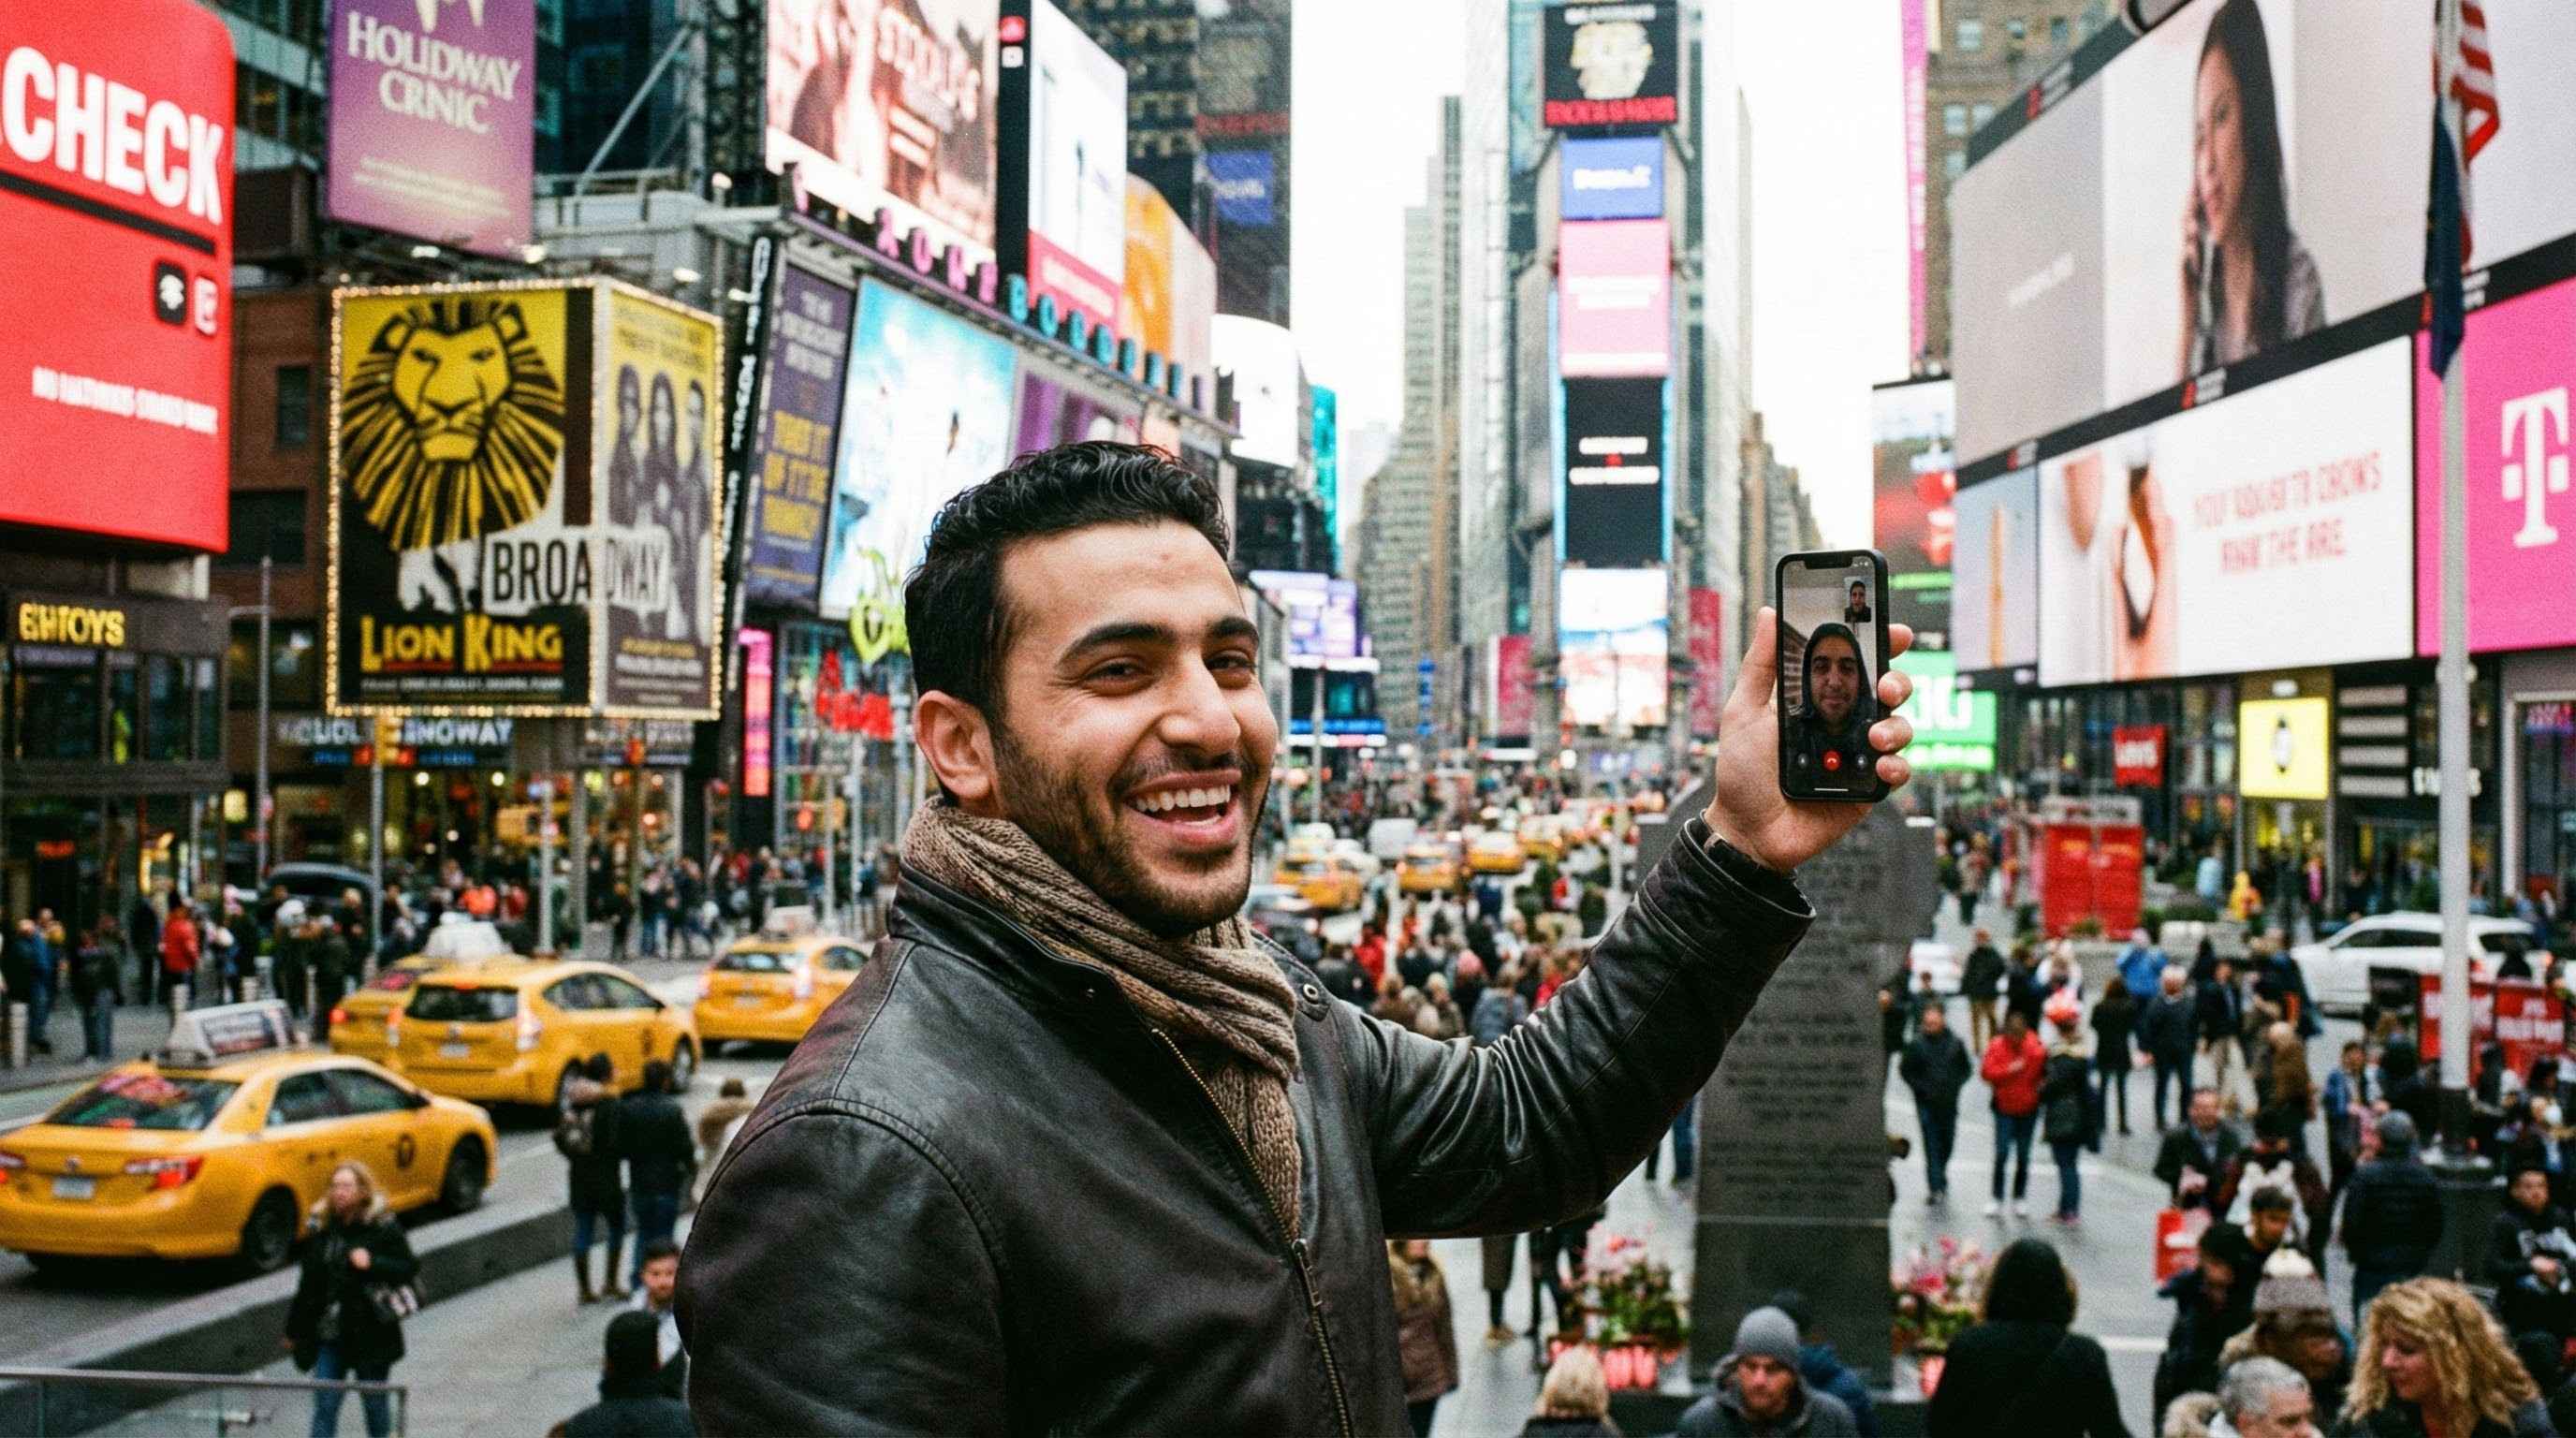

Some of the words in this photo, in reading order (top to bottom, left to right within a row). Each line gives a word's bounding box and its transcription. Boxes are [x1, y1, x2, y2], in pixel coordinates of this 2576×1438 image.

[3, 46, 225, 225] CHECK
[360, 615, 455, 673] LION
[463, 613, 564, 673] KING
